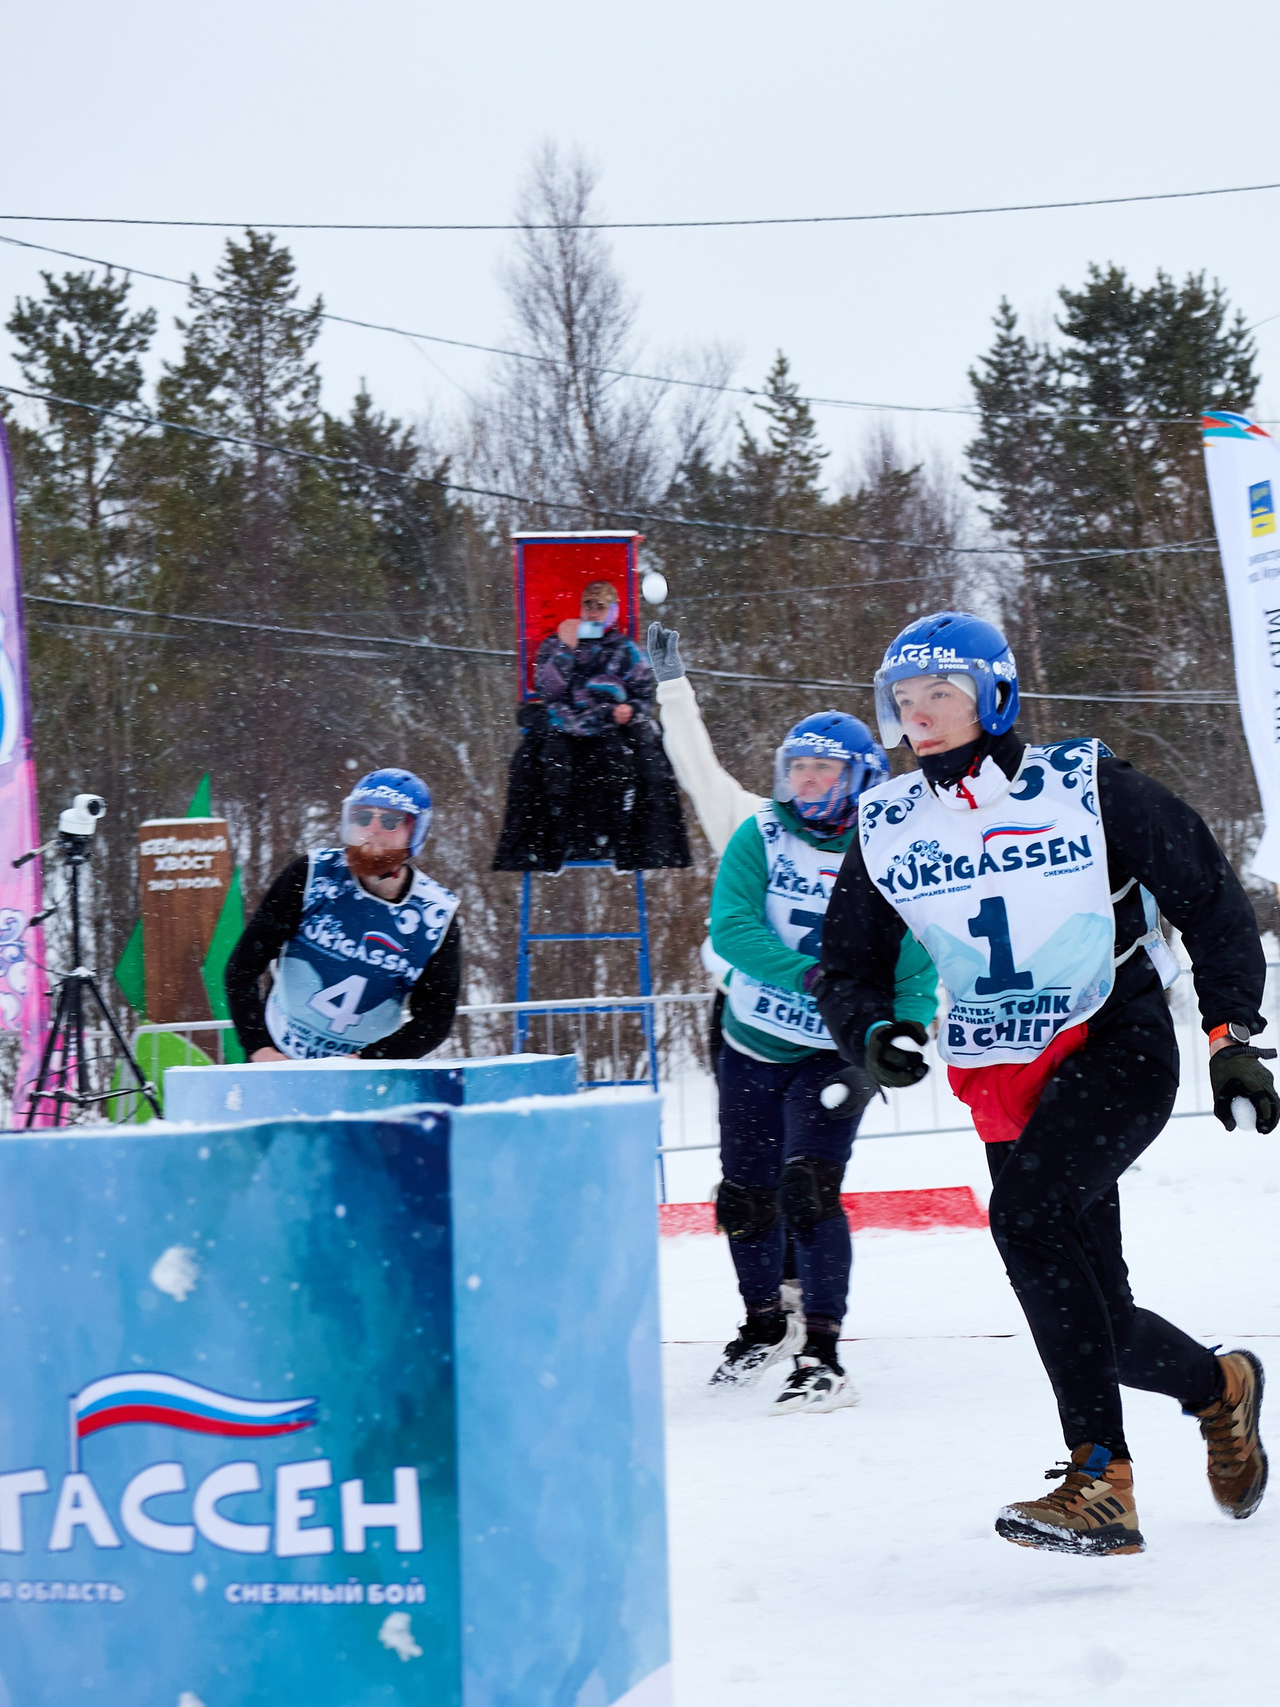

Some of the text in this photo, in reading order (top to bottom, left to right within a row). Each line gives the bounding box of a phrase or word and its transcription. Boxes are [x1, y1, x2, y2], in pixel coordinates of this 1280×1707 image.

[968, 896, 1034, 996] 1
[305, 974, 369, 1034] 4
[1000, 995, 1071, 1016] ТОЛК
[948, 1024, 967, 1047] В
[16, 1582, 126, 1602] ОБЛАСТЬ
[225, 1577, 426, 1604] СНЕЖНЫЙ БОЙ
